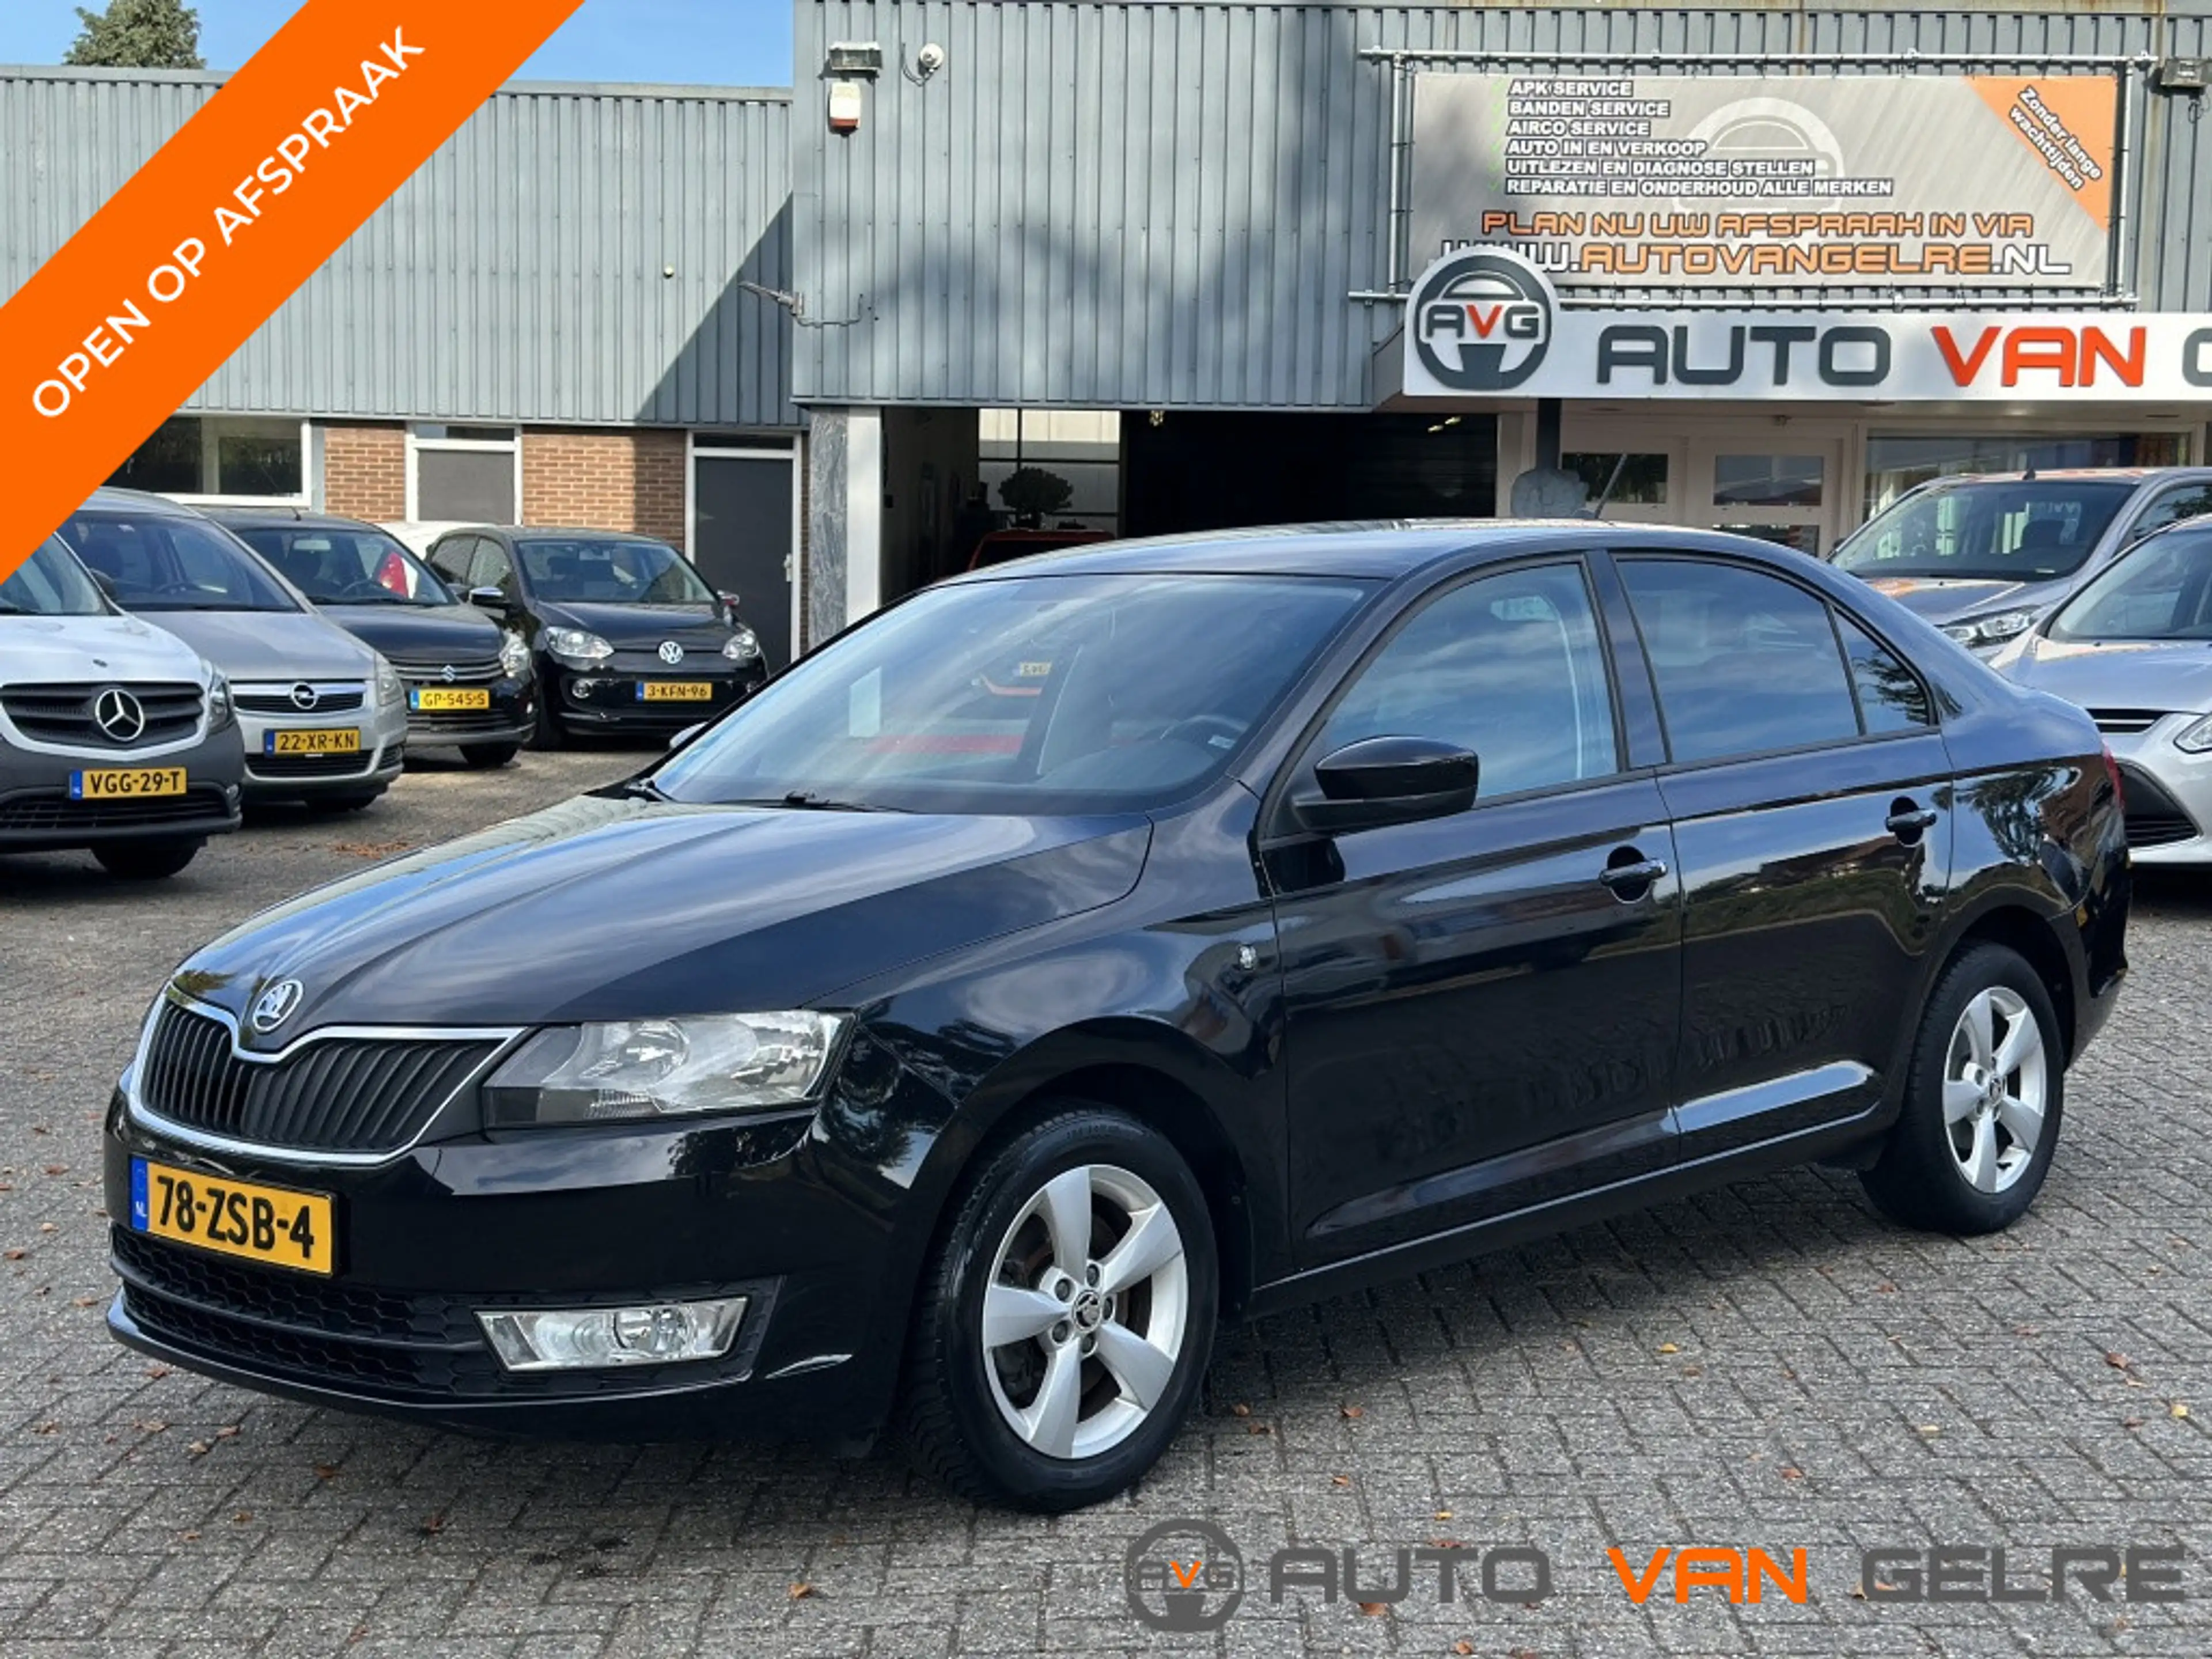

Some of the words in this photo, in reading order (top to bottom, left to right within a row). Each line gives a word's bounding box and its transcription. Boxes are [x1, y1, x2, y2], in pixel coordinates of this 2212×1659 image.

[1509, 81, 1550, 97] APK
[1552, 81, 1633, 97] SERVICE
[1508, 100, 1587, 117] BANDEN
[1589, 100, 1670, 117] SERVICE
[1506, 120, 1567, 137] AIRCO
[1569, 120, 1650, 137] SERVICE
[2018, 85, 2069, 140] Zonder
[2063, 135, 2103, 181] lange
[1505, 139, 1559, 156] AUTO
[1562, 140, 1583, 156] IN
[1586, 141, 1613, 156] EN
[1618, 140, 1707, 157] VERKOOP
[2009, 105, 2085, 191] wachttijden
[1506, 158, 1599, 175] UITLEZEN
[1601, 159, 1629, 175] EN
[1631, 160, 1728, 176] DIAGNOSE
[1730, 160, 1815, 177] STELLEN
[1505, 177, 1607, 195] REPARATIE
[1610, 179, 1638, 196] EN
[1640, 179, 1758, 197] ONDERHOUD
[1759, 179, 1809, 197] ALLE
[1813, 179, 1893, 197] MERKEN
[1482, 211, 1585, 236] PLAN
[1592, 212, 1643, 237] NU
[1652, 213, 1708, 238] UW
[1716, 212, 1921, 238] AFSPRAAK
[1930, 213, 1965, 237] IN
[1973, 213, 2033, 237] VIA
[1441, 240, 2071, 274] W.AUTOVANGELRE.NL
[1425, 305, 1539, 338] AVG
[1597, 325, 1891, 386] AUTO
[1931, 326, 2146, 387] VAN
[423, 692, 486, 707] GP-545-S
[647, 684, 707, 698] 3-KFN-96
[279, 732, 355, 751] 22-XR-KN
[90, 771, 180, 794] VGG-29-T
[157, 1175, 315, 1260] 78-ZSB-4
